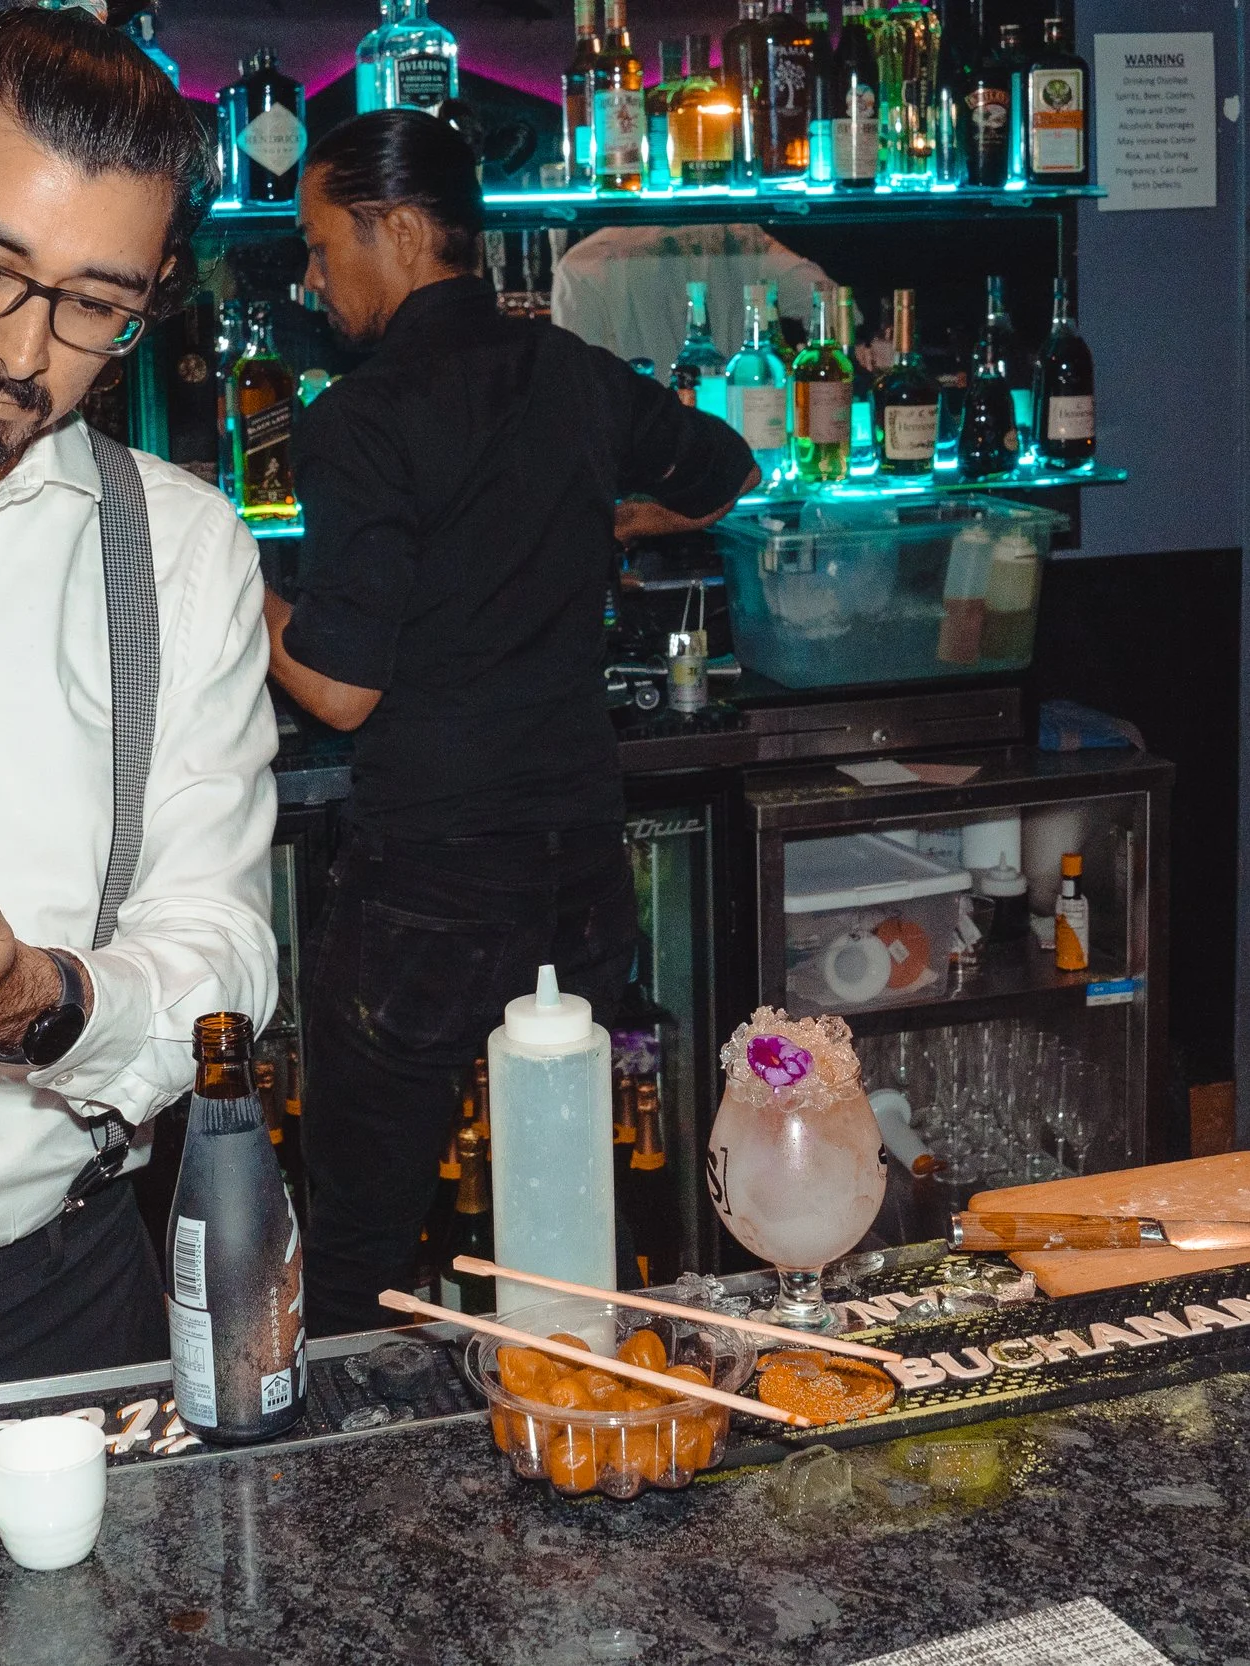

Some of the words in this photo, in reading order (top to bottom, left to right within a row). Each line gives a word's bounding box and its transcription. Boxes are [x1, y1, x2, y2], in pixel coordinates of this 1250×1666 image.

[1124, 53, 1185, 67] WARNING
[399, 60, 447, 72] AVIATION
[1123, 77, 1155, 86] Drinking
[1126, 106, 1146, 115] Wine
[1165, 106, 1187, 114] Other
[1119, 121, 1152, 130] Alcoholic
[1155, 122, 1195, 131] Beverages
[1117, 137, 1134, 146] May
[1163, 151, 1189, 160] During
[1159, 166, 1175, 175] Can
[1176, 166, 1199, 175] Cause
[1131, 181, 1150, 190] Birth
